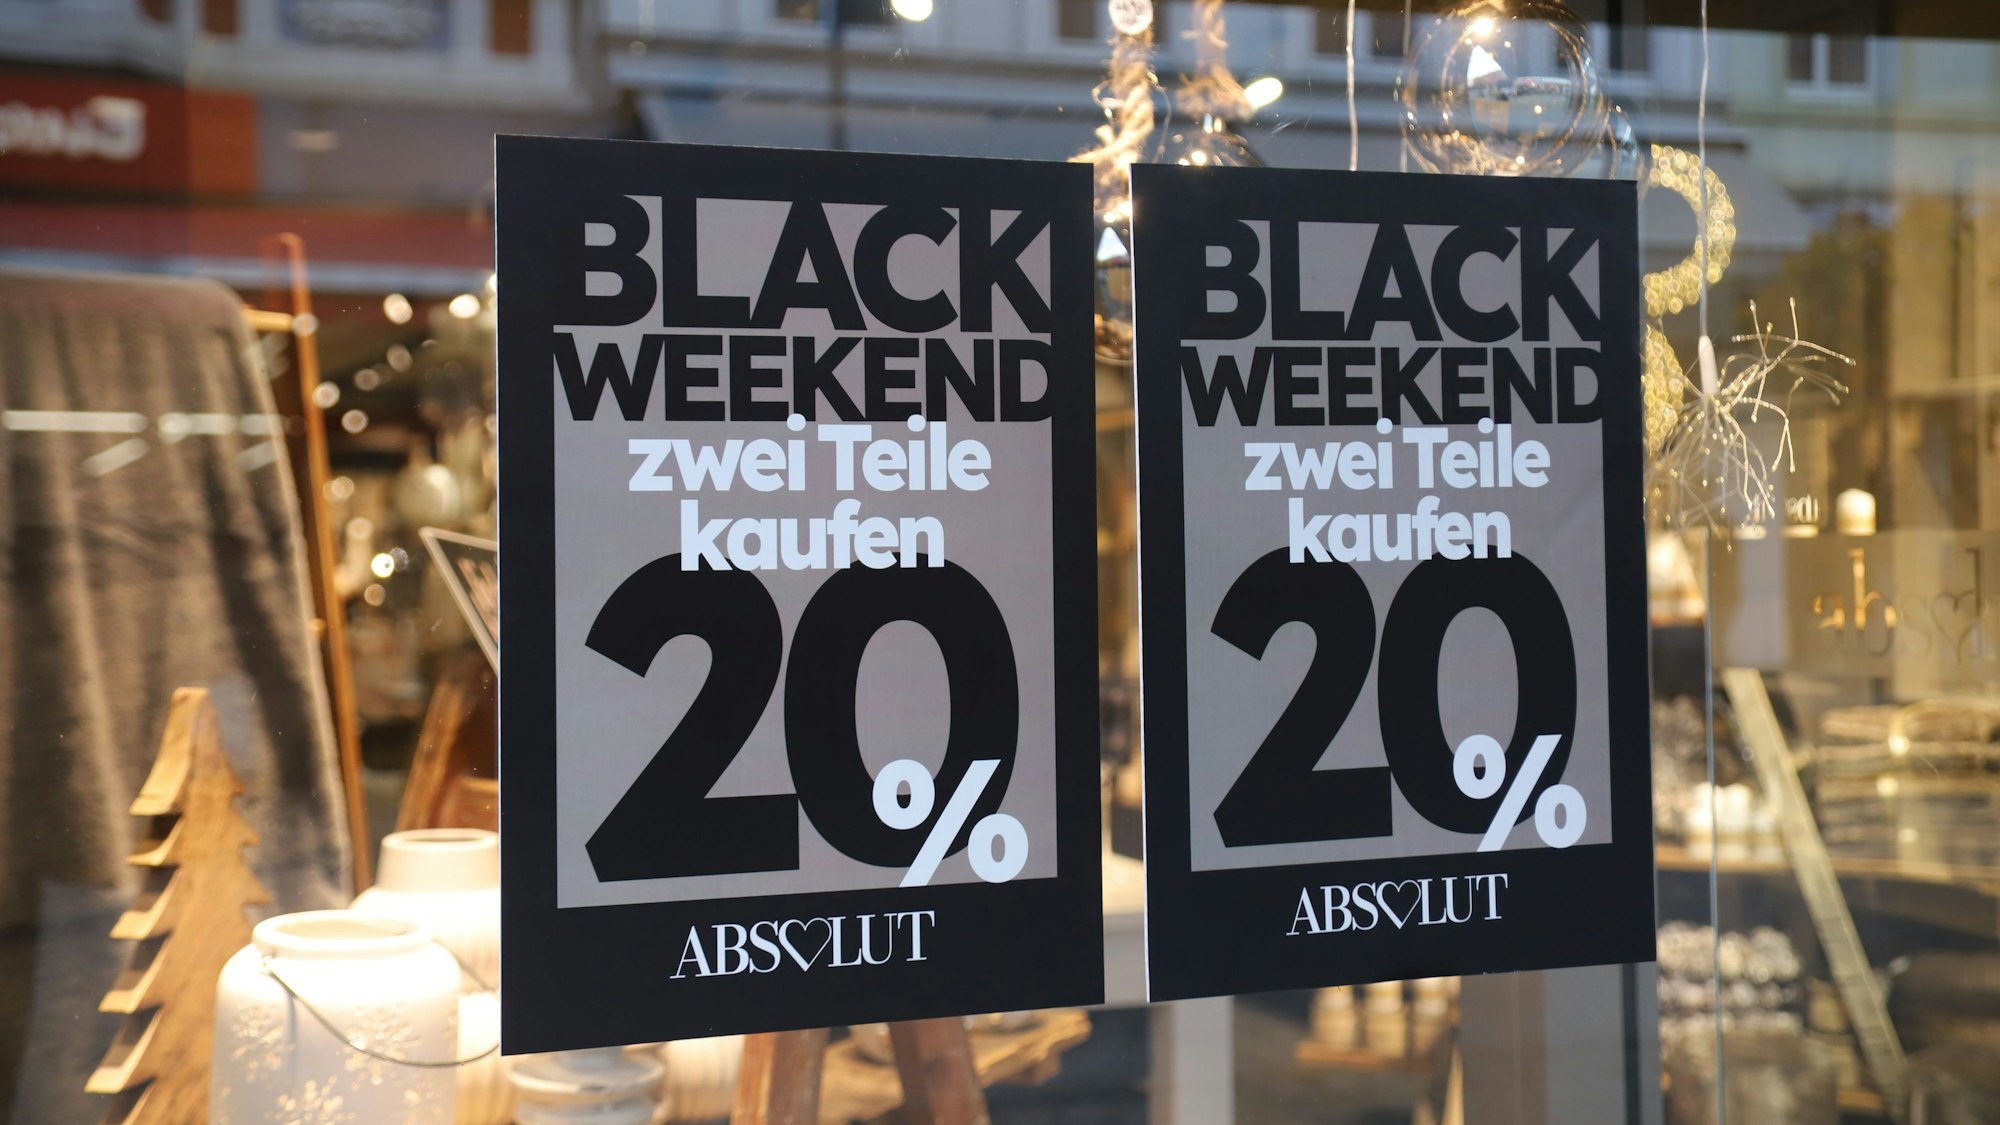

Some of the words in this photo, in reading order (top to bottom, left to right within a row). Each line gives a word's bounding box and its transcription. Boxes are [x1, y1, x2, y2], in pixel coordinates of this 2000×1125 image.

[553, 195, 1052, 333] BLACK
[1180, 220, 1601, 342] BLACK
[553, 332, 1054, 422] WEEKEND
[1180, 346, 1602, 426] WEEKEND
[628, 413, 806, 492] zwei
[818, 414, 992, 492] Teile
[1244, 417, 1394, 491] zwei
[1402, 417, 1551, 489] Teile
[680, 498, 945, 571] kaufen
[1288, 495, 1512, 564] kaufen
[585, 552, 1029, 887] 20%
[1210, 544, 1587, 852] 20%
